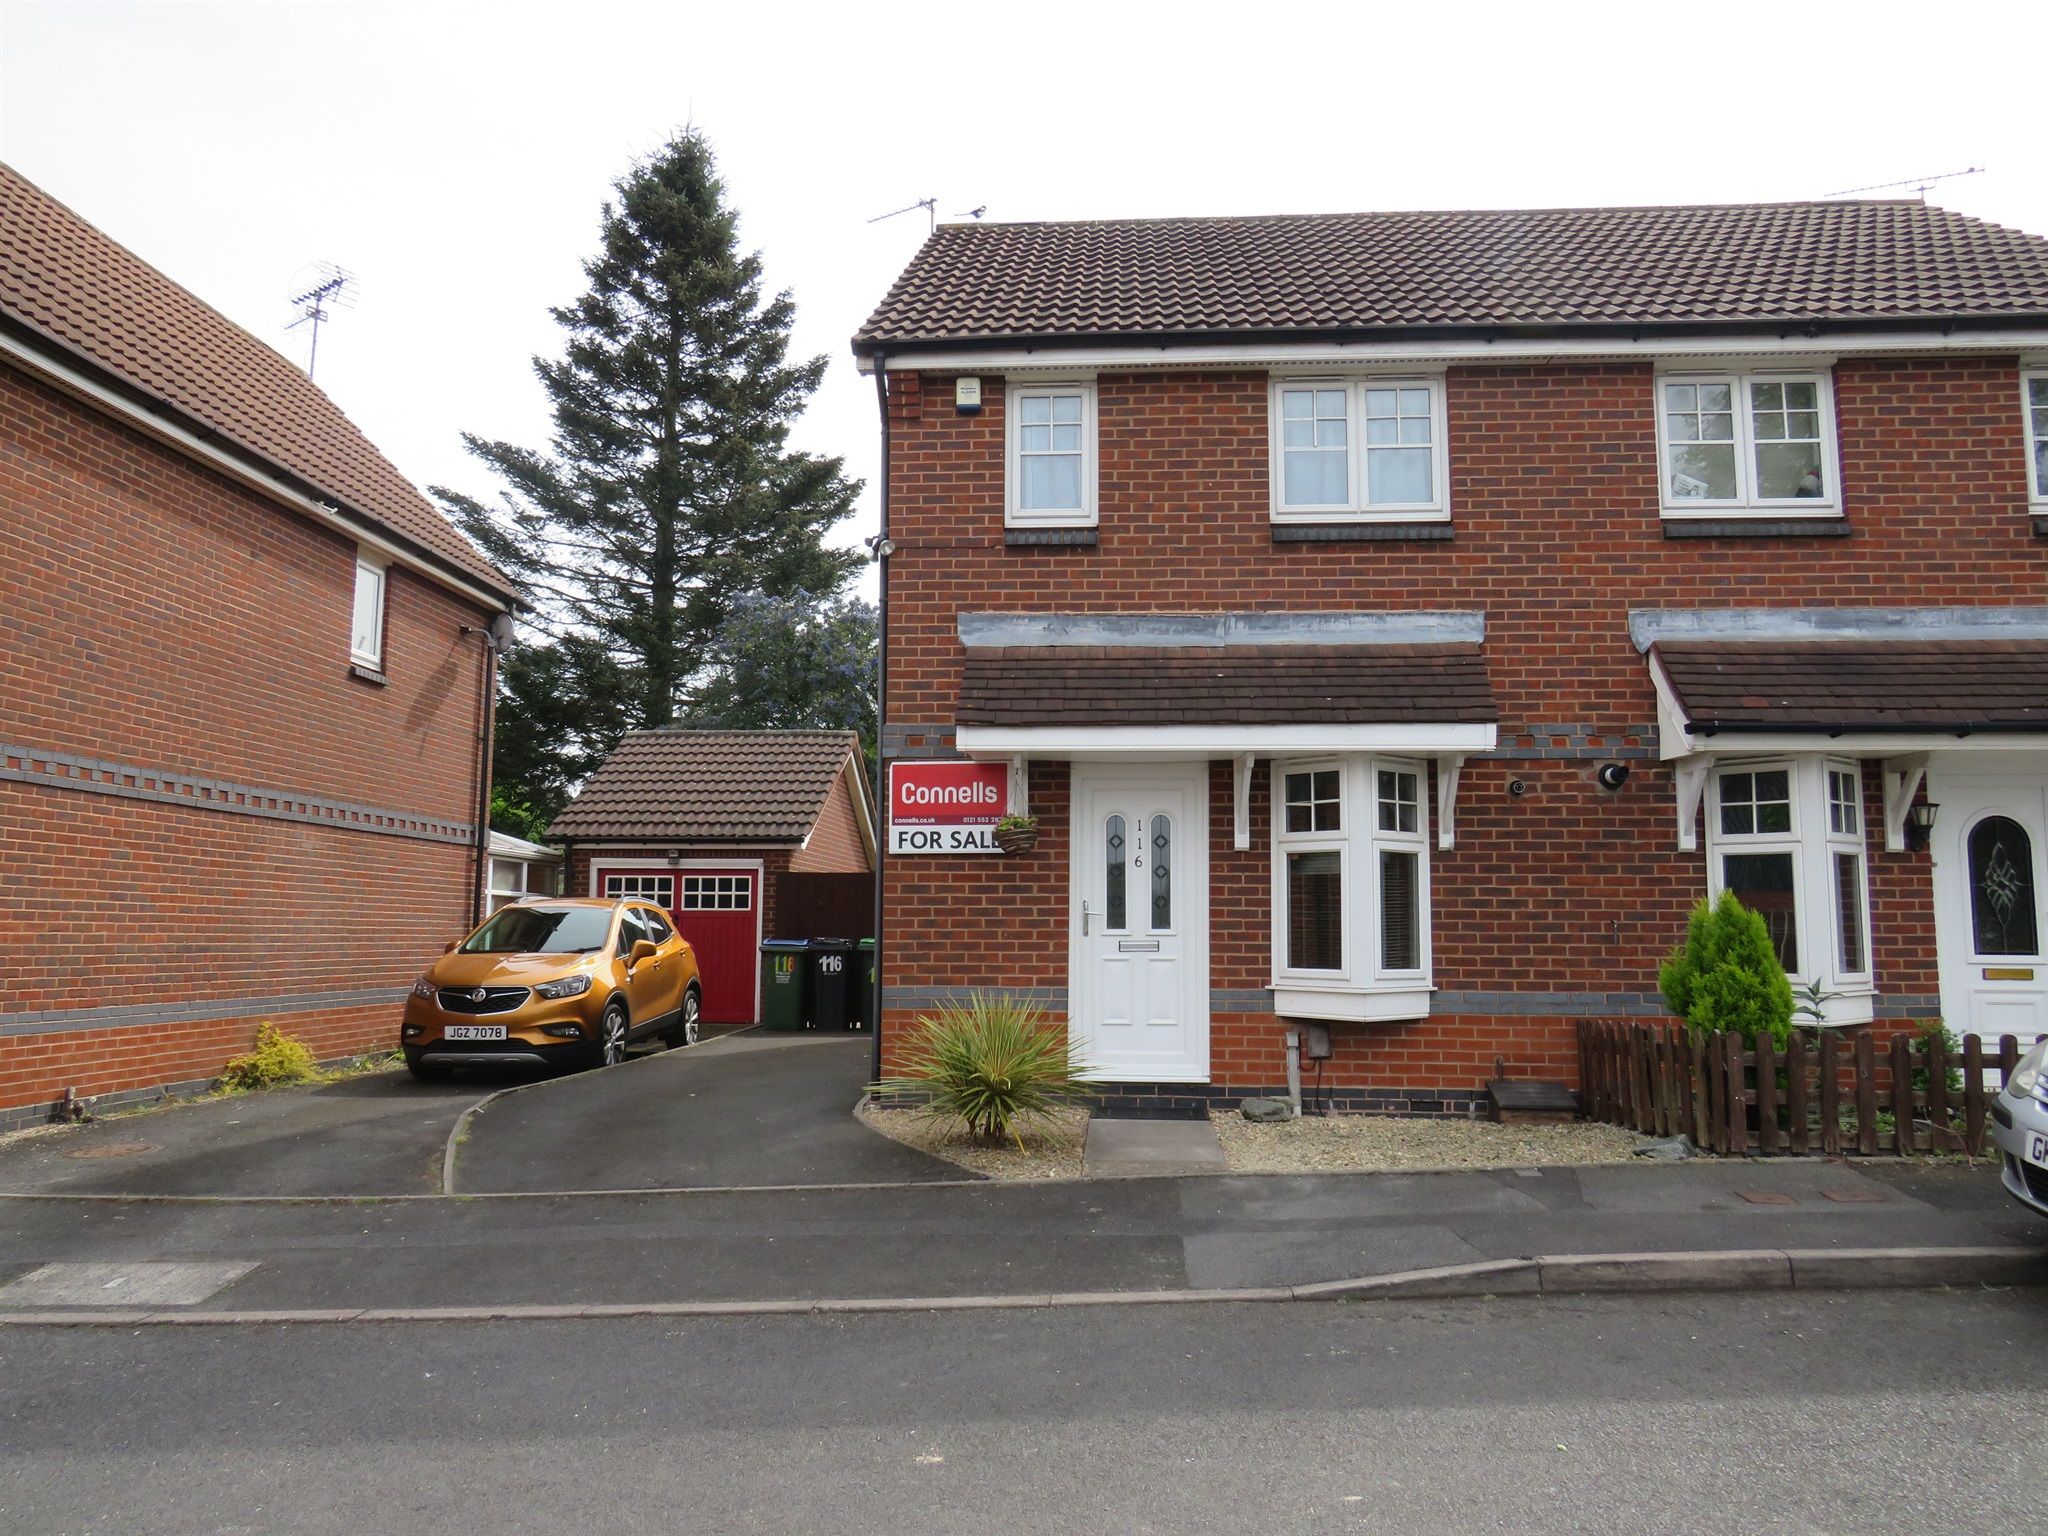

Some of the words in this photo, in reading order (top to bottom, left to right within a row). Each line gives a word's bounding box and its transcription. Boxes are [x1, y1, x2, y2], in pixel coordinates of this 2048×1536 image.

[901, 782, 998, 804] Connells
[898, 831, 943, 849] FOR
[818, 955, 842, 972] 116
[450, 1027, 470, 1038] JGZ
[473, 1027, 502, 1038] 7078
